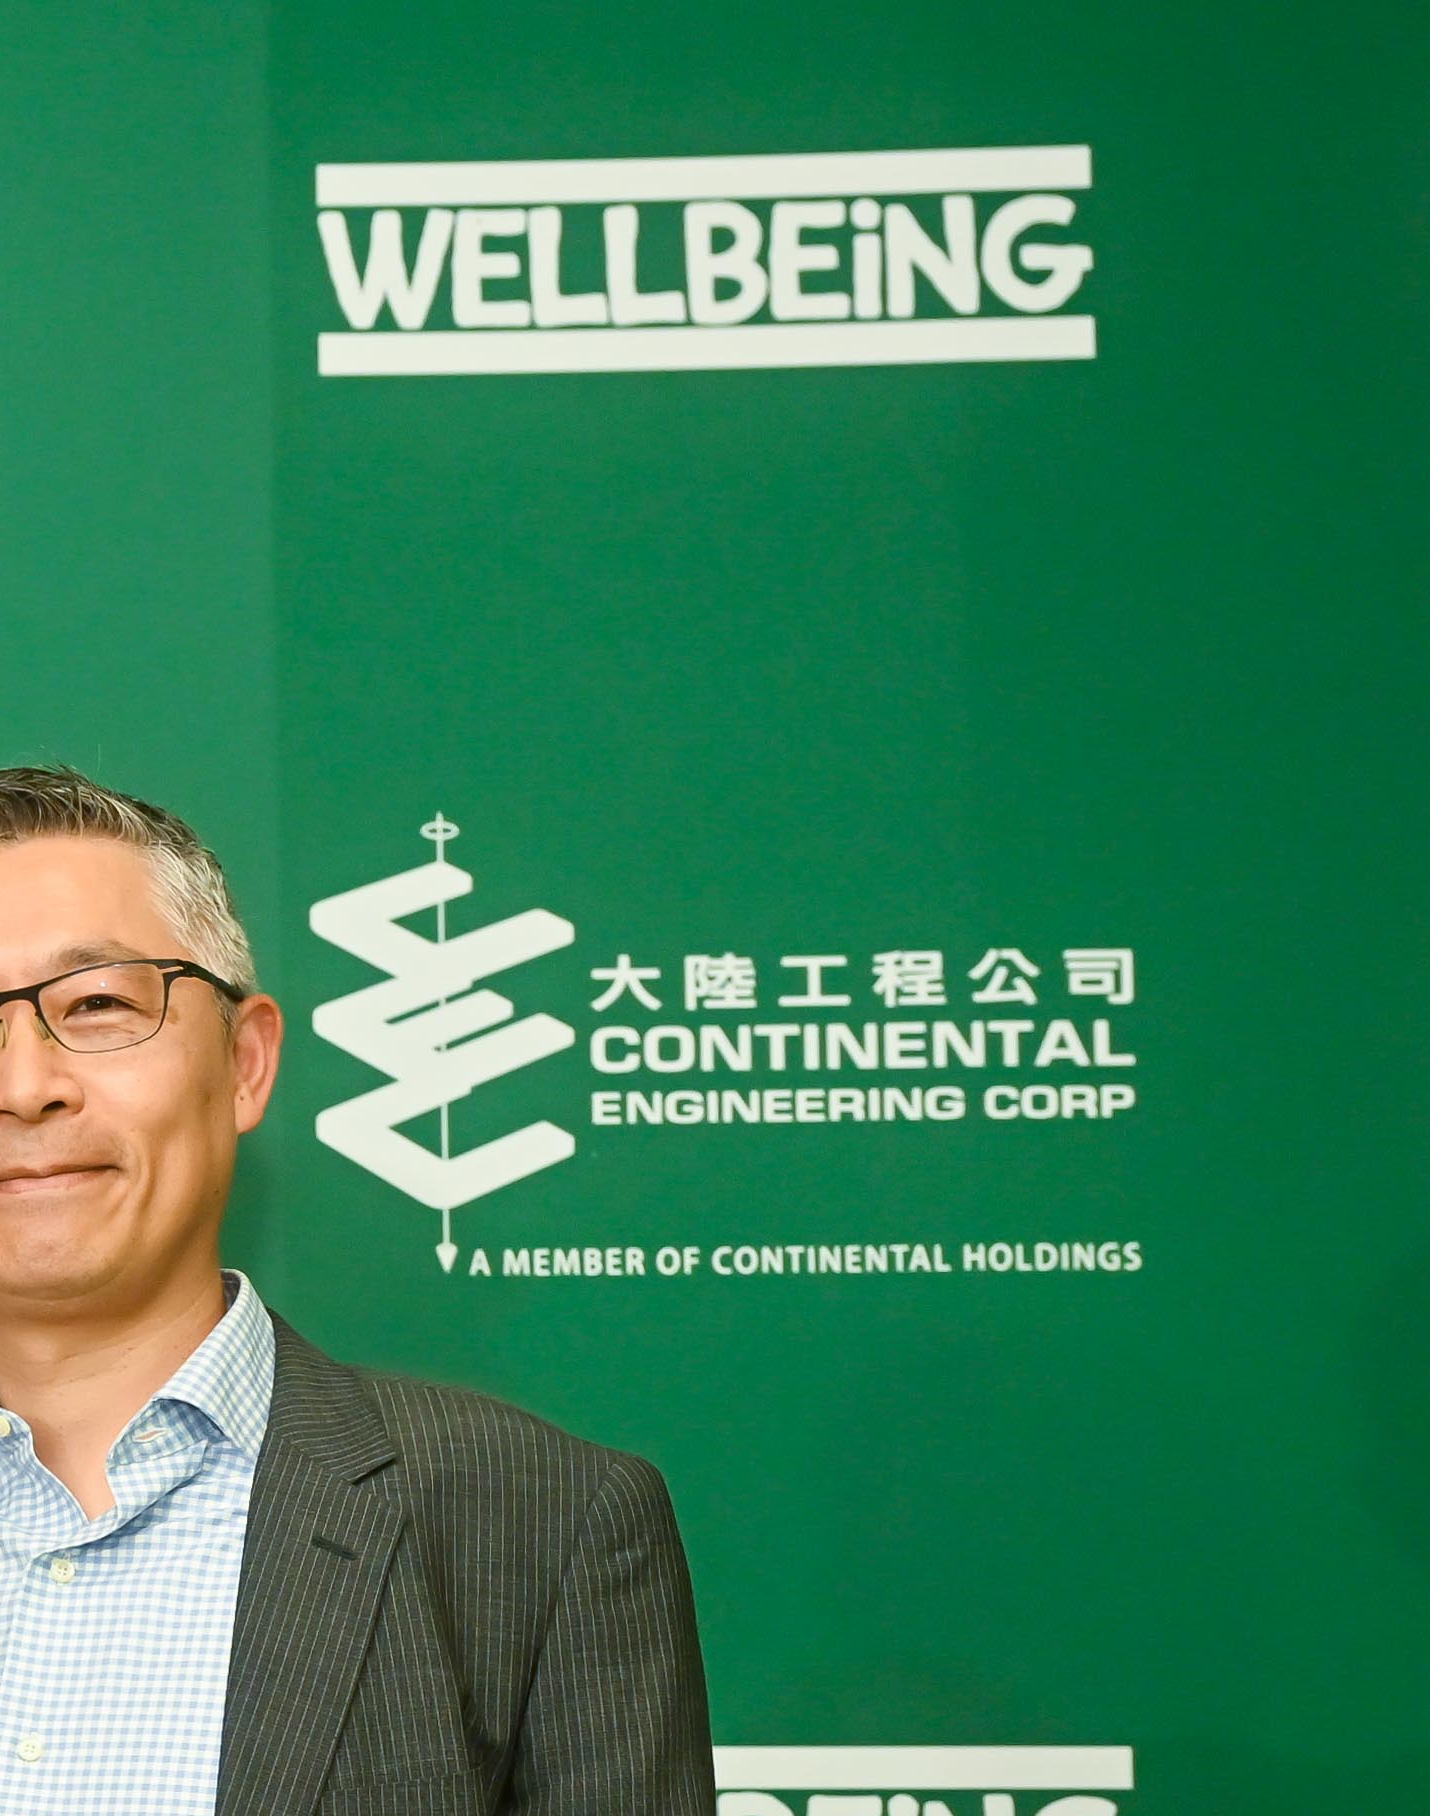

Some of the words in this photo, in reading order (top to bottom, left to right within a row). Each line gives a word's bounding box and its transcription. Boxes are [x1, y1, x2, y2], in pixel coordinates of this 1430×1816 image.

[590, 948, 1135, 1012] 大陸工程公司
[590, 1018, 1137, 1074] CONTINENTAL
[591, 1085, 966, 1126] ENGINEERING
[983, 1084, 1136, 1120] CORP
[469, 1248, 492, 1277] A
[502, 1246, 646, 1277] MEMBER
[655, 1246, 701, 1276] OF
[711, 1243, 952, 1276] CONTINENTAL
[962, 1241, 1143, 1272] HOLDINGS
